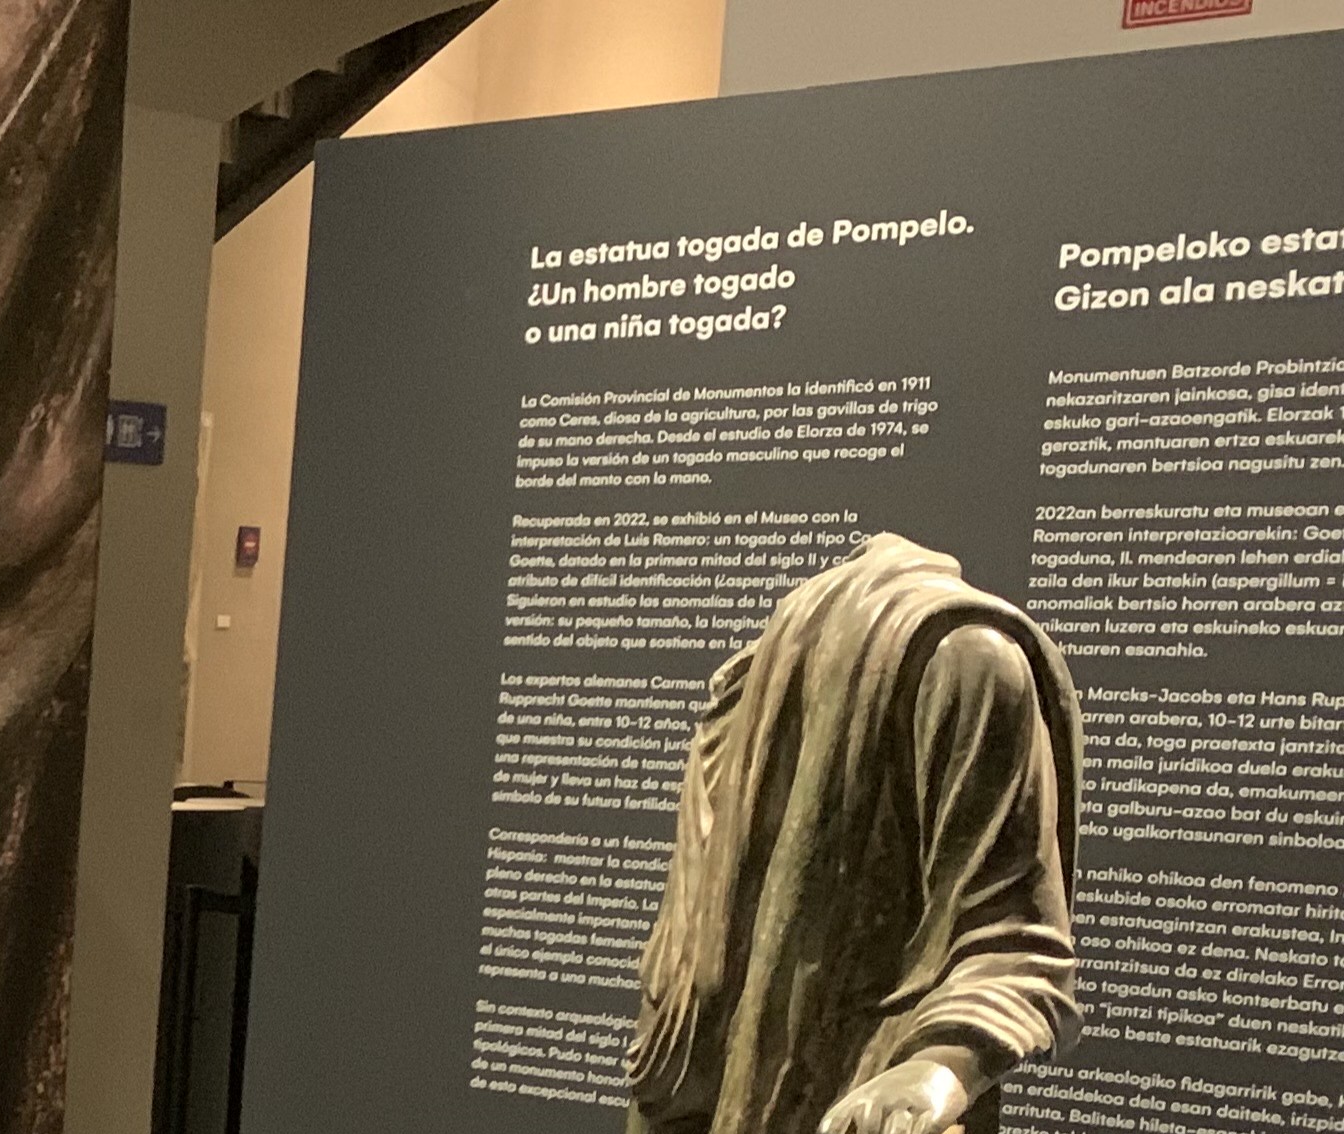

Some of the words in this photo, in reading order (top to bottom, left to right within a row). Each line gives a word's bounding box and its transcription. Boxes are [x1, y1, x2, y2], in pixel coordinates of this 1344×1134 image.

[532, 247, 562, 268] La
[569, 241, 669, 266] estatua
[677, 226, 779, 262] togada
[788, 222, 823, 248] de
[833, 210, 974, 246] Pompelo.
[1060, 231, 1250, 270] Pompeloko
[528, 282, 576, 306] ¿Un
[584, 274, 686, 302] hombre
[694, 264, 795, 299] togado
[1055, 283, 1149, 310] Gizon
[1160, 276, 1214, 304] ala
[525, 327, 541, 344] o
[549, 324, 596, 342] una
[604, 314, 661, 338] niña
[669, 305, 786, 340] togada?
[1049, 369, 1166, 384] Monumentuen
[1172, 362, 1251, 378] Batzorde
[522, 396, 537, 408] La
[540, 392, 600, 407] Comisión
[604, 388, 670, 404] Provincial
[673, 388, 690, 401] de
[694, 386, 783, 400] Monumentos
[788, 382, 800, 396] la
[805, 379, 874, 395] identificó
[878, 381, 896, 392] en
[902, 376, 930, 390] 1911
[1046, 390, 1170, 406] nekazaritzaren
[1258, 384, 1295, 402] gisa
[520, 417, 556, 428] como
[560, 414, 600, 426] Ceres,
[604, 412, 640, 425] diosa
[644, 410, 661, 423] de
[665, 410, 677, 422] la
[681, 406, 760, 424] agricultura,
[764, 408, 789, 421] por
[792, 404, 813, 416] las
[817, 401, 874, 419] gavillas
[879, 400, 898, 413] de
[903, 399, 938, 415] trigo
[1044, 414, 1101, 430] eskuko
[1267, 406, 1333, 422] Elorzak
[518, 435, 535, 448] de
[538, 438, 552, 447] su
[556, 436, 593, 446] mano
[596, 431, 654, 445] derecha.
[658, 428, 700, 443] Desde
[704, 428, 716, 442] el
[719, 426, 770, 441] estudio
[774, 426, 793, 439] de
[797, 424, 842, 438] Elorza
[847, 423, 866, 436] de
[871, 422, 906, 436] 1974,
[912, 424, 928, 434] se
[1042, 436, 1112, 456] geroztik,
[1117, 437, 1209, 450] mantuaren
[1214, 435, 1260, 447] ertza
[517, 455, 563, 470] impuso
[566, 454, 578, 466] la
[582, 452, 629, 466] versión
[632, 452, 649, 464] de
[653, 454, 669, 464] un
[673, 449, 722, 466] togado
[726, 447, 798, 461] masculino
[803, 449, 830, 462] que
[834, 448, 886, 460] recoge
[891, 443, 904, 456] el
[1040, 460, 1146, 478] togadunaren
[1152, 457, 1223, 472] bertsioa
[1228, 455, 1304, 473] nagusitu
[516, 474, 554, 488] borde
[556, 473, 576, 486] del
[580, 474, 622, 486] manto
[625, 475, 650, 485] con
[654, 472, 666, 484] la
[670, 474, 712, 484] mano.
[513, 514, 591, 529] Recuperada
[594, 517, 610, 526] en
[614, 513, 649, 526] 2022,
[653, 516, 668, 525] se
[672, 512, 721, 525] exhibió
[724, 515, 741, 524] en
[745, 511, 758, 524] el
[761, 512, 808, 524] Museo
[812, 513, 840, 523] con
[844, 509, 857, 522] la
[1036, 506, 1096, 520] 2022an
[1101, 504, 1209, 519] berreskuratu
[1214, 505, 1242, 517] eta
[1247, 506, 1329, 517] museoan
[1088, 687, 1222, 704] Marcks-Jacobs
[1227, 692, 1255, 704] eta
[1261, 692, 1306, 706] Hans
[1078, 1068, 1176, 1090] arkeologiko
[1181, 1076, 1276, 1100] fidagarririk
[1282, 1090, 1332, 1108] gabe,
